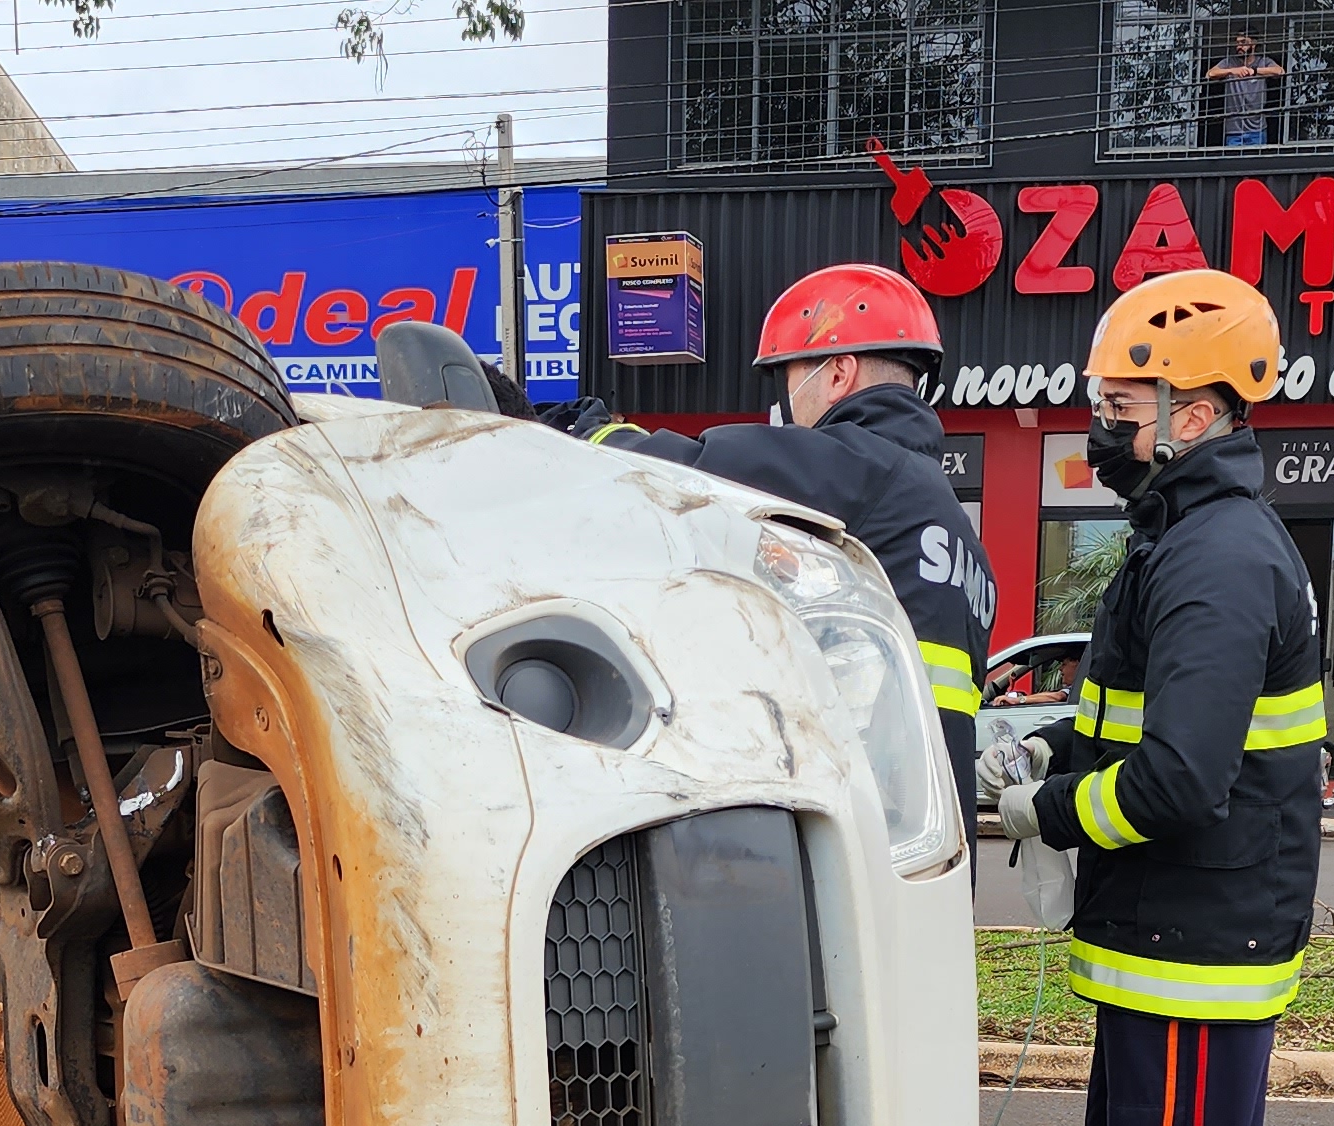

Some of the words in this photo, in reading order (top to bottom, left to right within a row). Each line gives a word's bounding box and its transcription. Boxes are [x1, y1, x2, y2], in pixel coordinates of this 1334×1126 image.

[630, 254, 678, 267] Suvinil
[951, 362, 1076, 406] novo
[919, 525, 996, 631] SAMU
